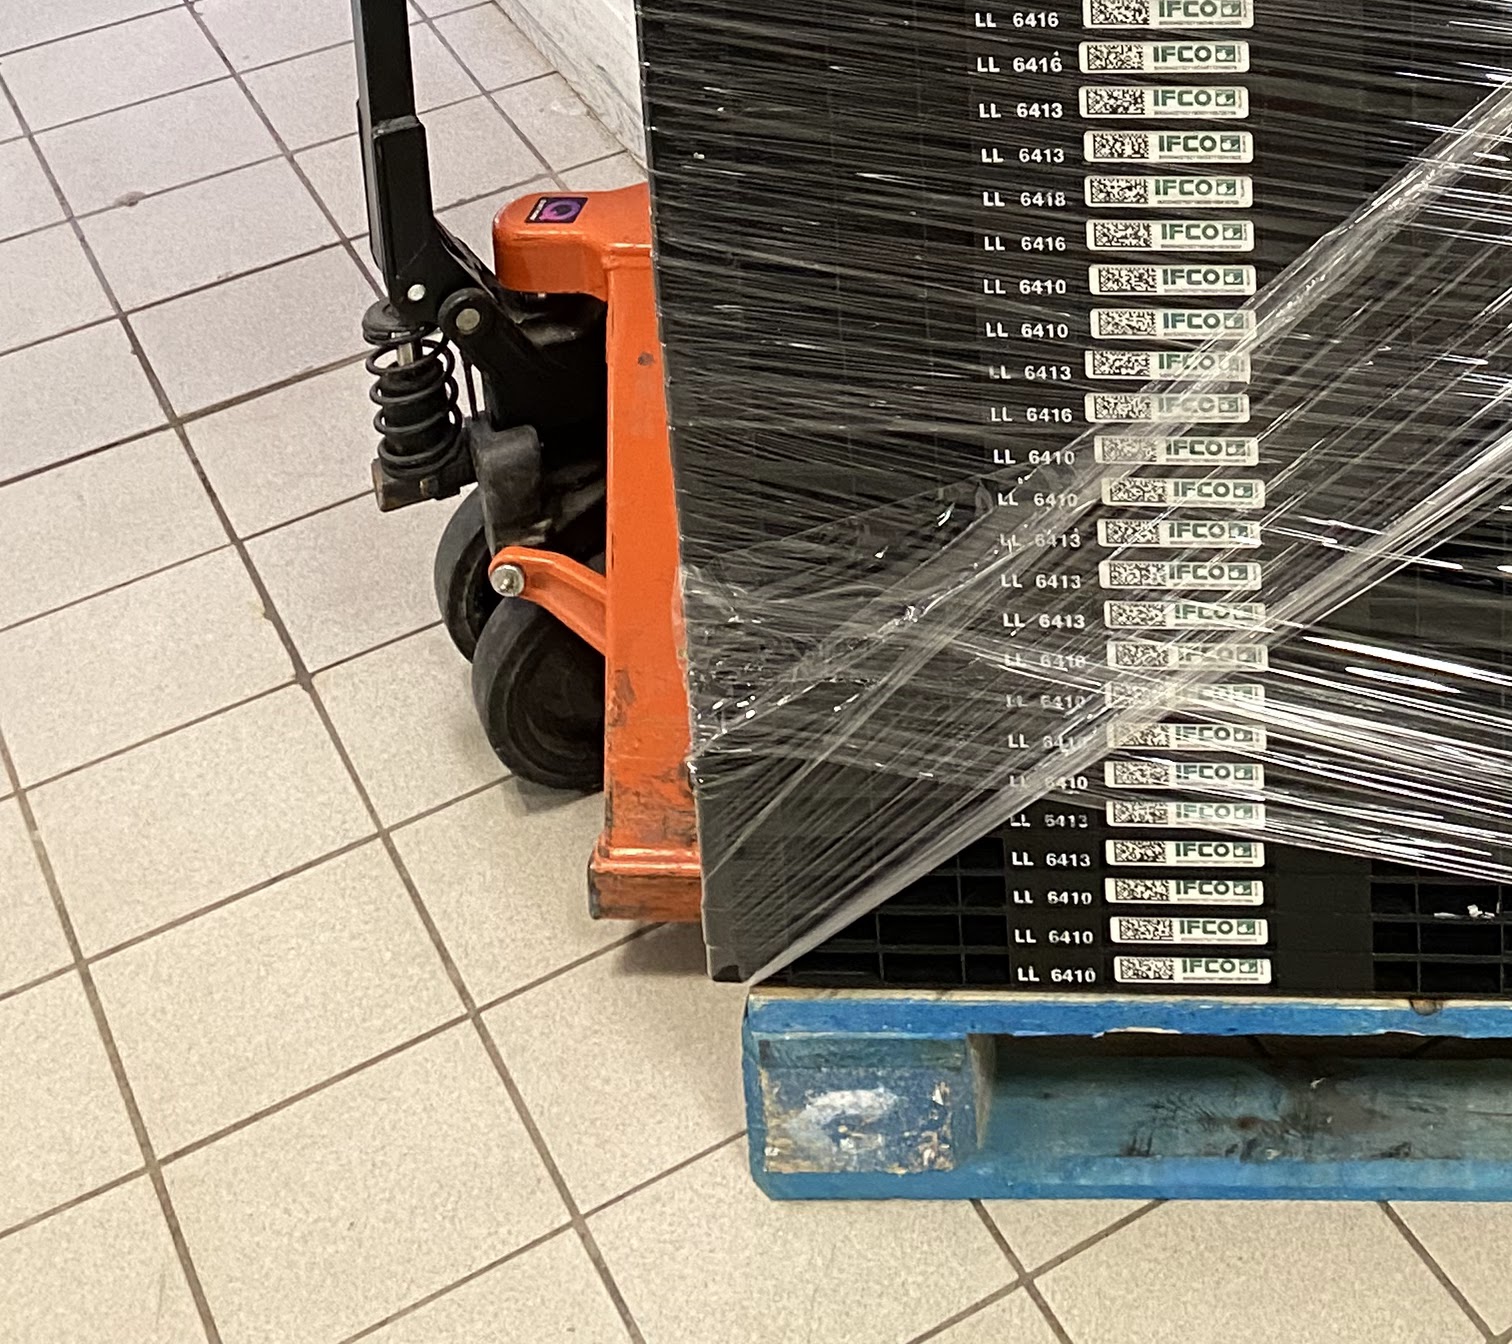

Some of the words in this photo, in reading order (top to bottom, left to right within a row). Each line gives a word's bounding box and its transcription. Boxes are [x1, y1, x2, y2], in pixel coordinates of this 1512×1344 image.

[975, 13, 996, 28] LL
[1013, 12, 1059, 28] 6416
[1159, 0, 1217, 18] IFCO
[985, 236, 1005, 251] LL
[1021, 236, 1066, 251] 6416
[1161, 223, 1219, 241] IFCO
[1012, 851, 1034, 866] LL
[1046, 853, 1090, 867] 6413
[1175, 841, 1230, 858] IFCO
[1015, 929, 1036, 943] LL
[1049, 930, 1093, 944] 6410
[1179, 918, 1233, 935] IFCO
[1018, 966, 1039, 982] LL
[1051, 968, 1095, 983] 6410
[1182, 957, 1236, 974] IFCO
